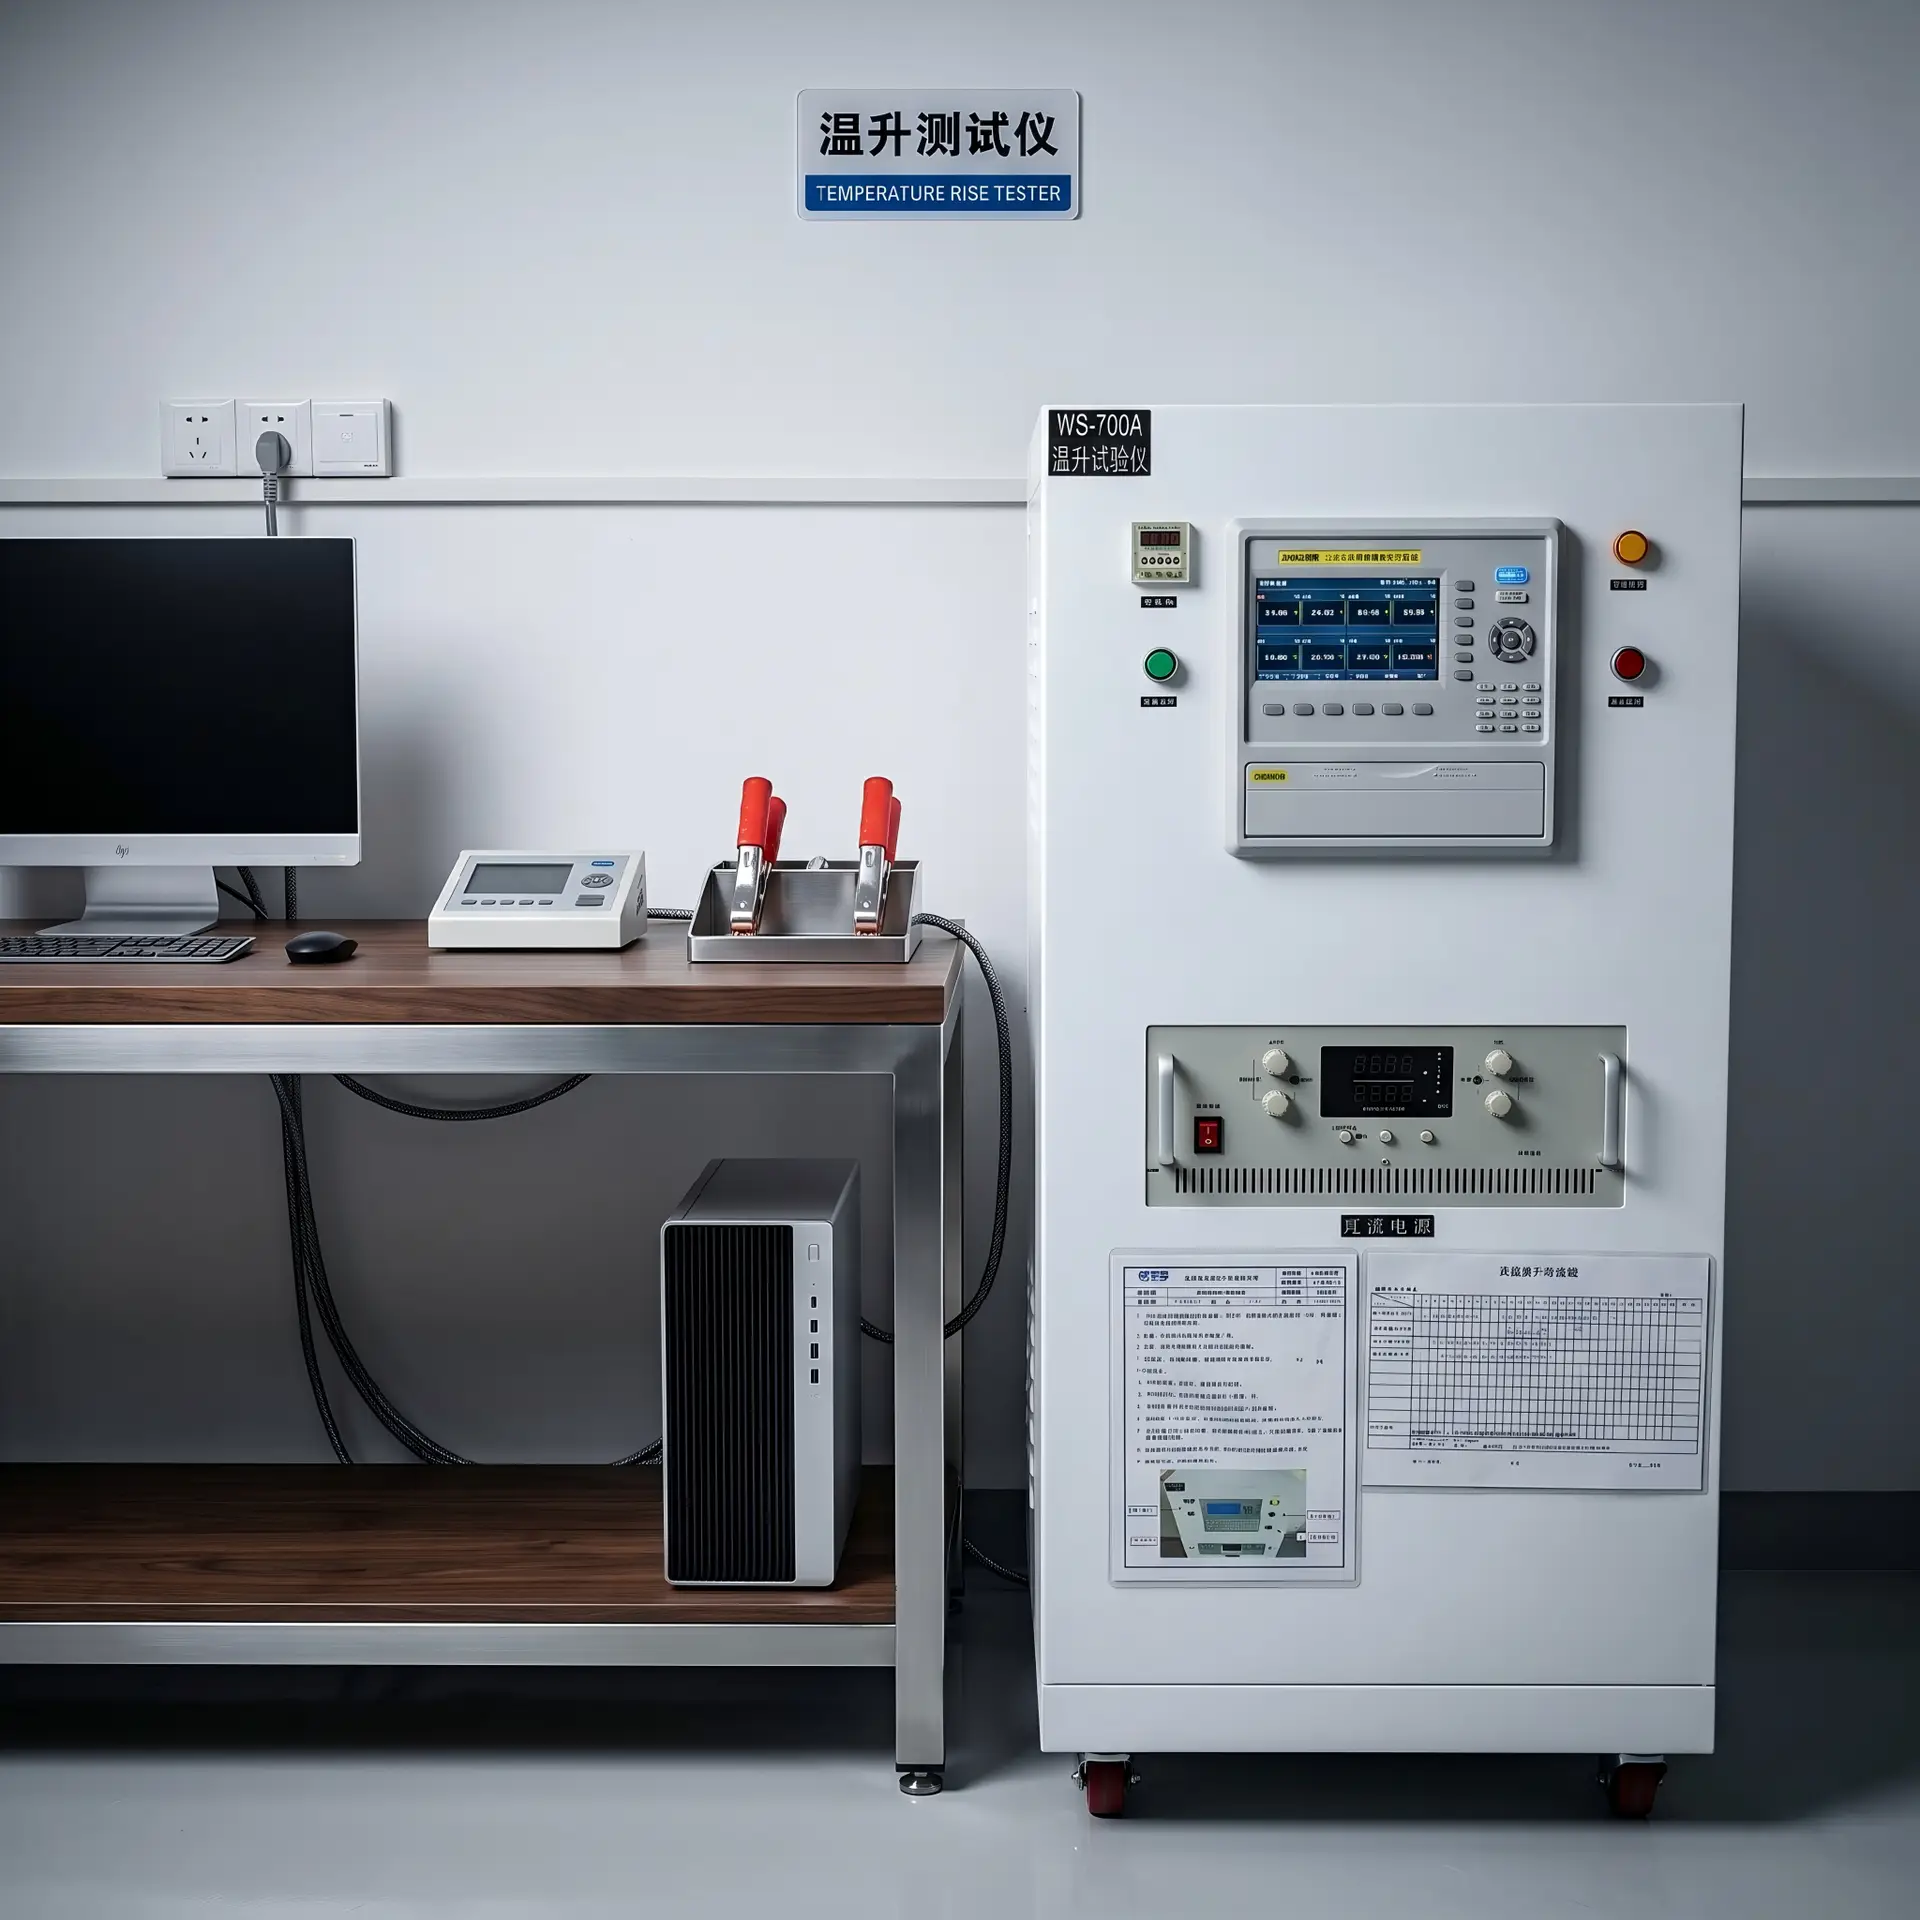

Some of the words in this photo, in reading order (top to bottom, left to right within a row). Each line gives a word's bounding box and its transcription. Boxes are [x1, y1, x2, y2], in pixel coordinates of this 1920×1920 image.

[819, 110, 1059, 158] 温升测试仪
[816, 185, 945, 202] TEMPERATURE
[950, 185, 990, 202] RISE
[993, 185, 1061, 202] TESTER
[1056, 412, 1143, 437] WS-700A
[1052, 444, 1149, 474] 温升试验仪
